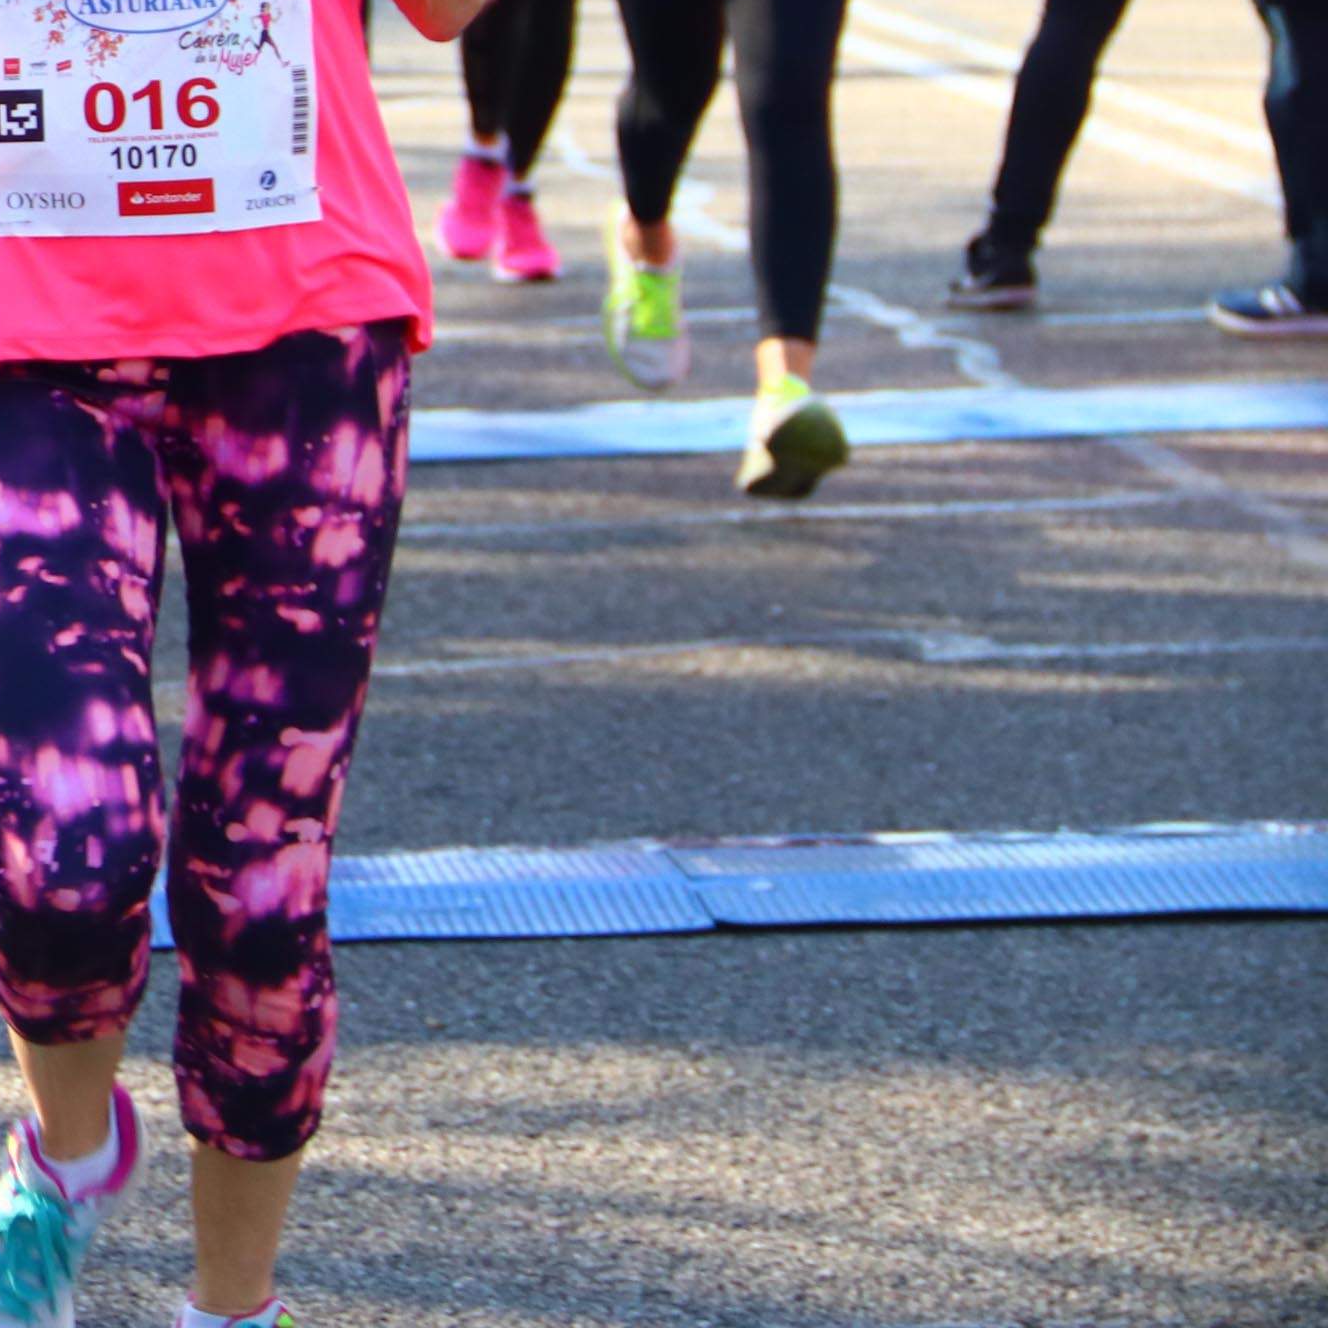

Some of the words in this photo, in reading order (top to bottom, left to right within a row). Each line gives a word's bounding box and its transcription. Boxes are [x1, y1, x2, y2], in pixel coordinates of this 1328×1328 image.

[83, 77, 221, 133] 016
[110, 143, 198, 171] 10170
[6, 191, 86, 211] OYSHO
[145, 192, 203, 205] Santander
[245, 194, 296, 212] ZURICH
